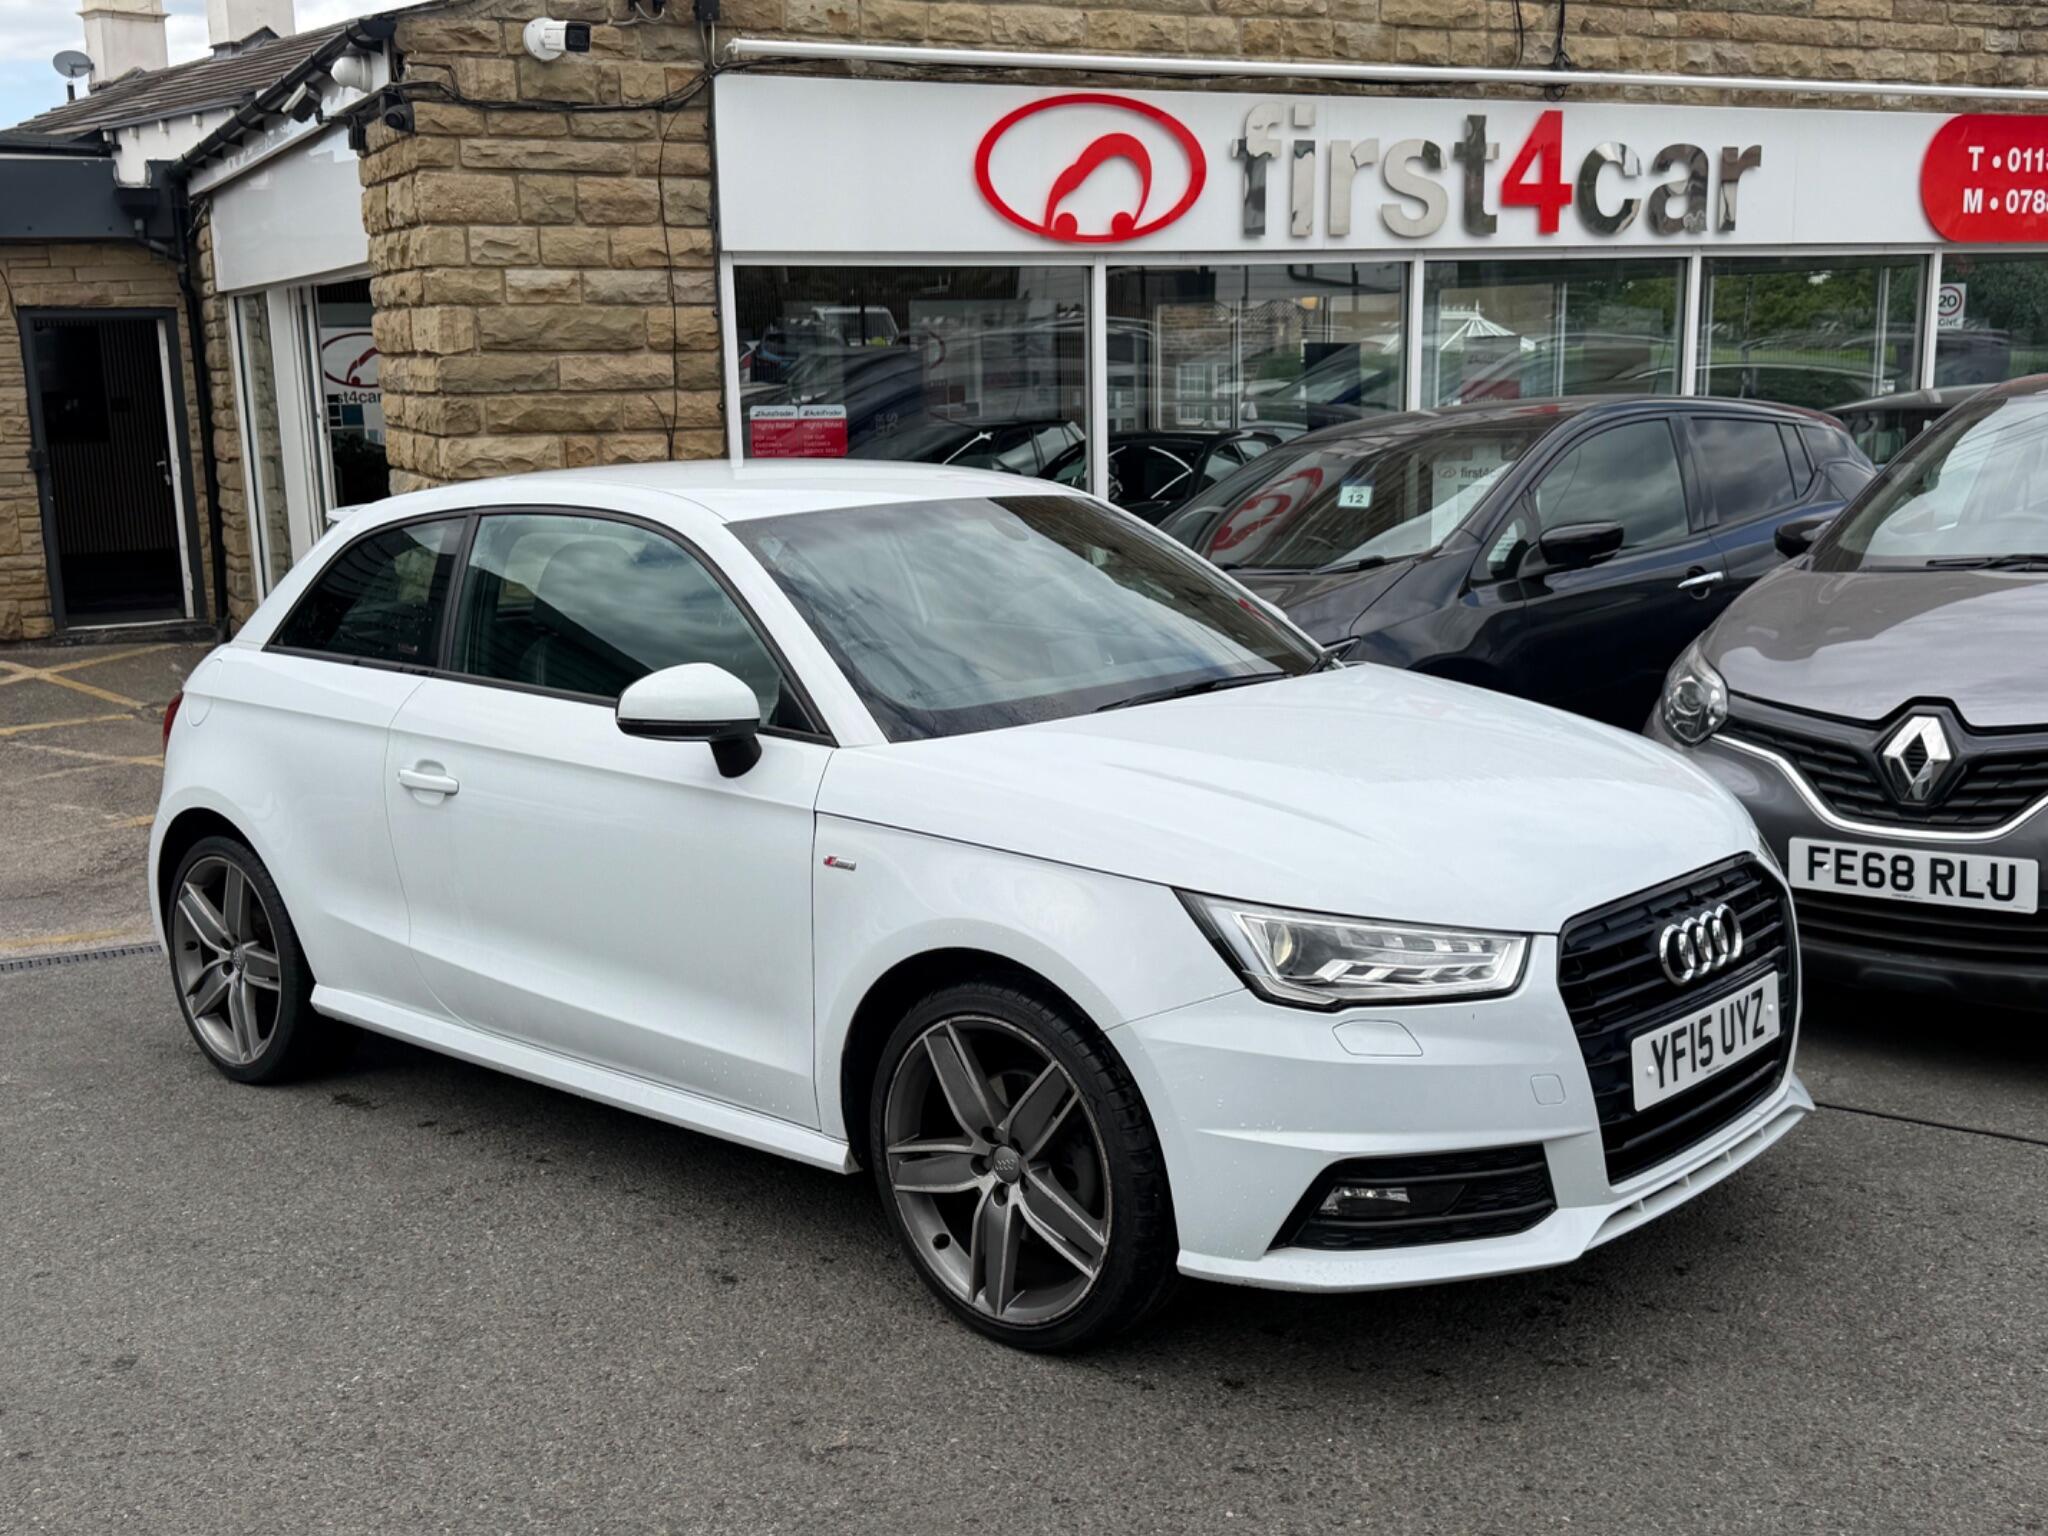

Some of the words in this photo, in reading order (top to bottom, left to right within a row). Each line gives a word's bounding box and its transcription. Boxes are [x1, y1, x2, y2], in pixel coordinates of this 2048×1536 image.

[1232, 101, 1762, 238] first4car
[1968, 145, 1985, 172] T
[2007, 146, 2048, 173] 011
[1962, 187, 1984, 214] M
[2005, 188, 2048, 215] 078
[1347, 493, 1365, 504] 12
[1807, 844, 1915, 892] FE68
[1929, 857, 2017, 902] RLU
[1650, 1013, 1714, 1089] YF15
[1720, 986, 1765, 1056] UYZ
